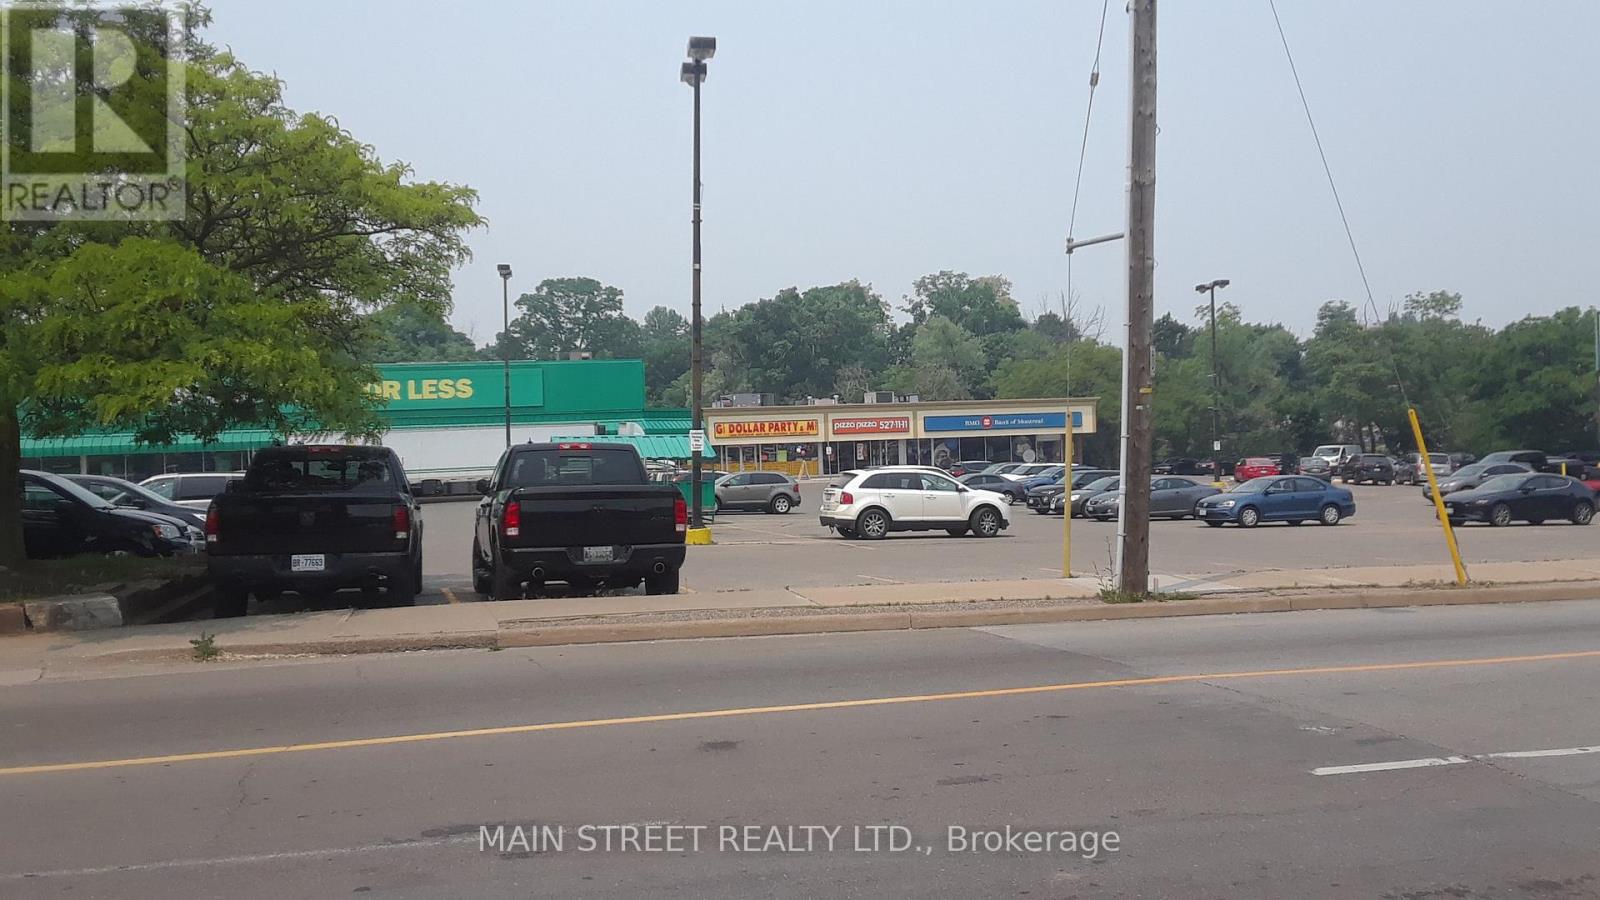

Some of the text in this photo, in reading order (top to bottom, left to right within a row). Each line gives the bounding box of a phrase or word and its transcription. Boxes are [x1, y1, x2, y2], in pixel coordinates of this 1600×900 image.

[408, 378, 474, 400] LESS
[728, 422, 766, 434] DOLLAR
[768, 421, 798, 433] PARTY
[834, 422, 855, 430] pizza
[856, 421, 877, 430] pizza
